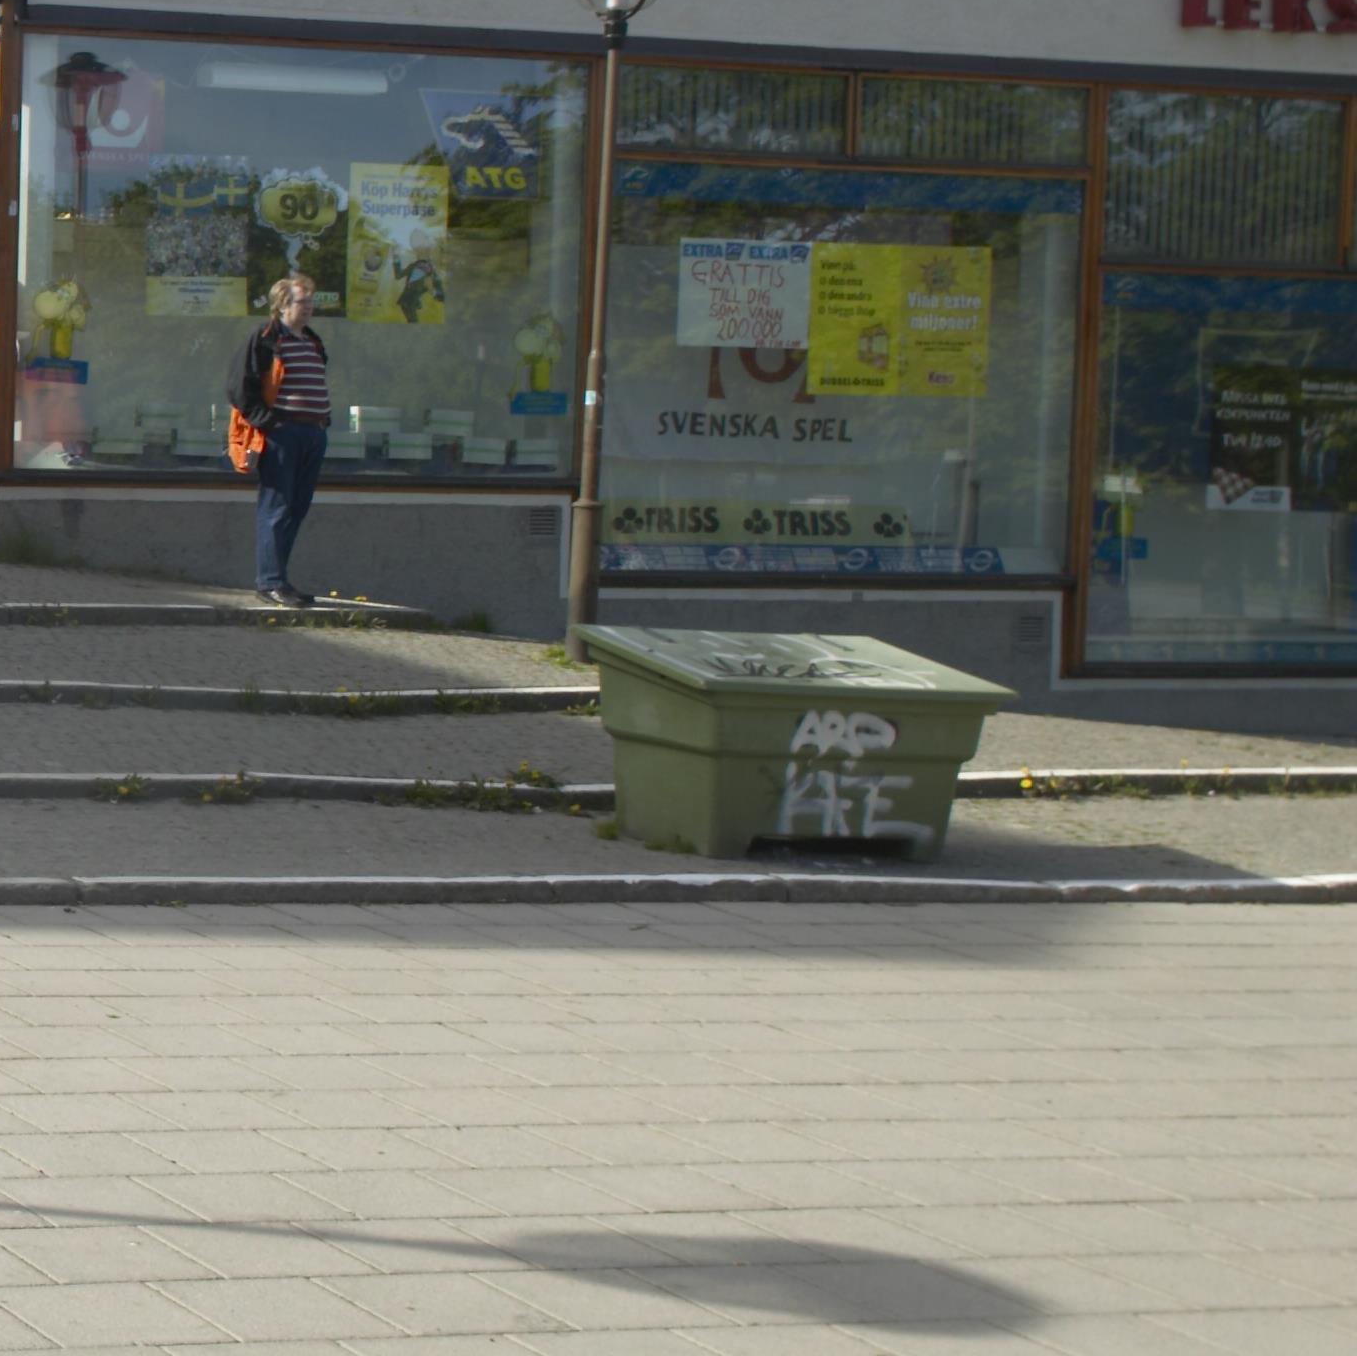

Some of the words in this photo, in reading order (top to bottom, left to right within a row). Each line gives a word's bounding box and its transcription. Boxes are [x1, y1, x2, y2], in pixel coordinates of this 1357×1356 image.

[361, 179, 388, 199] Köp
[465, 166, 527, 190] ATG
[280, 193, 319, 221] 90
[683, 244, 724, 257] EXTRA
[691, 259, 785, 288] GRATTIS
[709, 287, 742, 303] TILL
[747, 288, 770, 306] DIG
[709, 303, 741, 318] SOM
[657, 411, 780, 440] SVENSKA
[793, 418, 853, 444] SPEL
[644, 506, 720, 534] TRISS
[772, 509, 853, 537] TRISS
